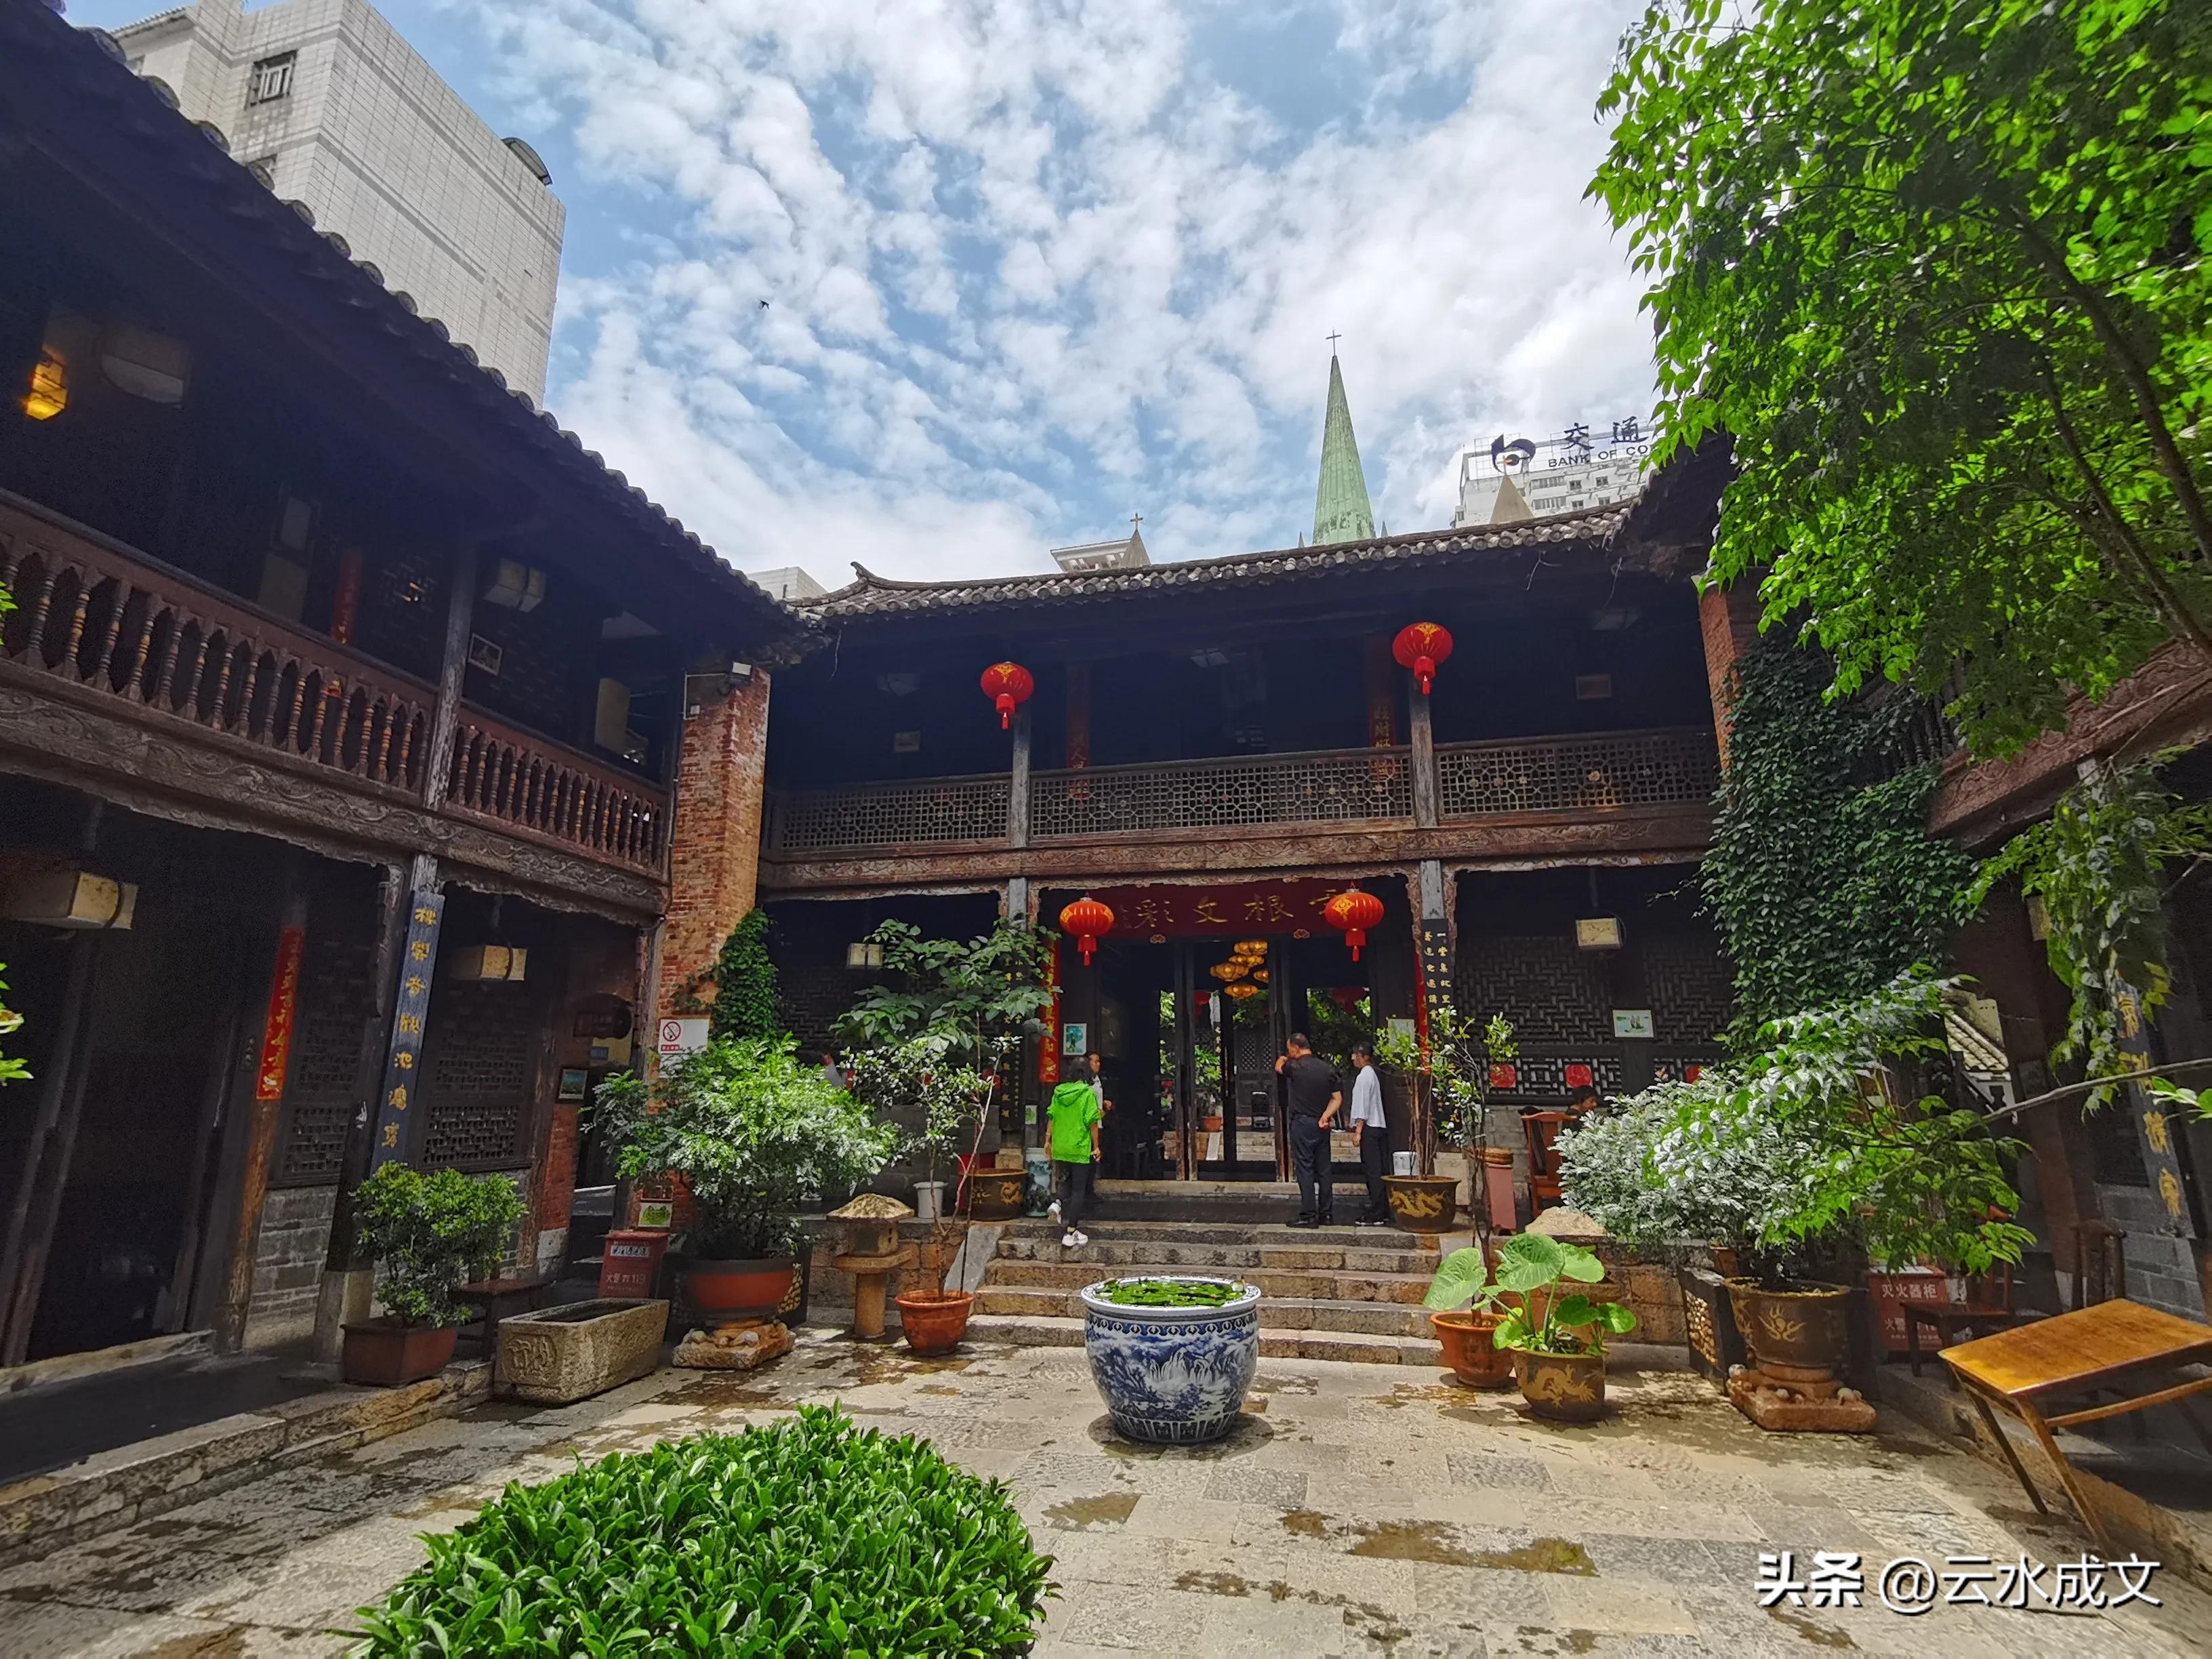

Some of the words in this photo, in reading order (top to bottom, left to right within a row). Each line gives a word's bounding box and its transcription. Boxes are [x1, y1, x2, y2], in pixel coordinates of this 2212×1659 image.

[1560, 416, 1649, 450] 交通
[1548, 453, 1591, 468] BANK
[1598, 449, 1617, 460] OF
[1626, 445, 1648, 455] CO
[1881, 1282, 1938, 1299] 灭火器柜
